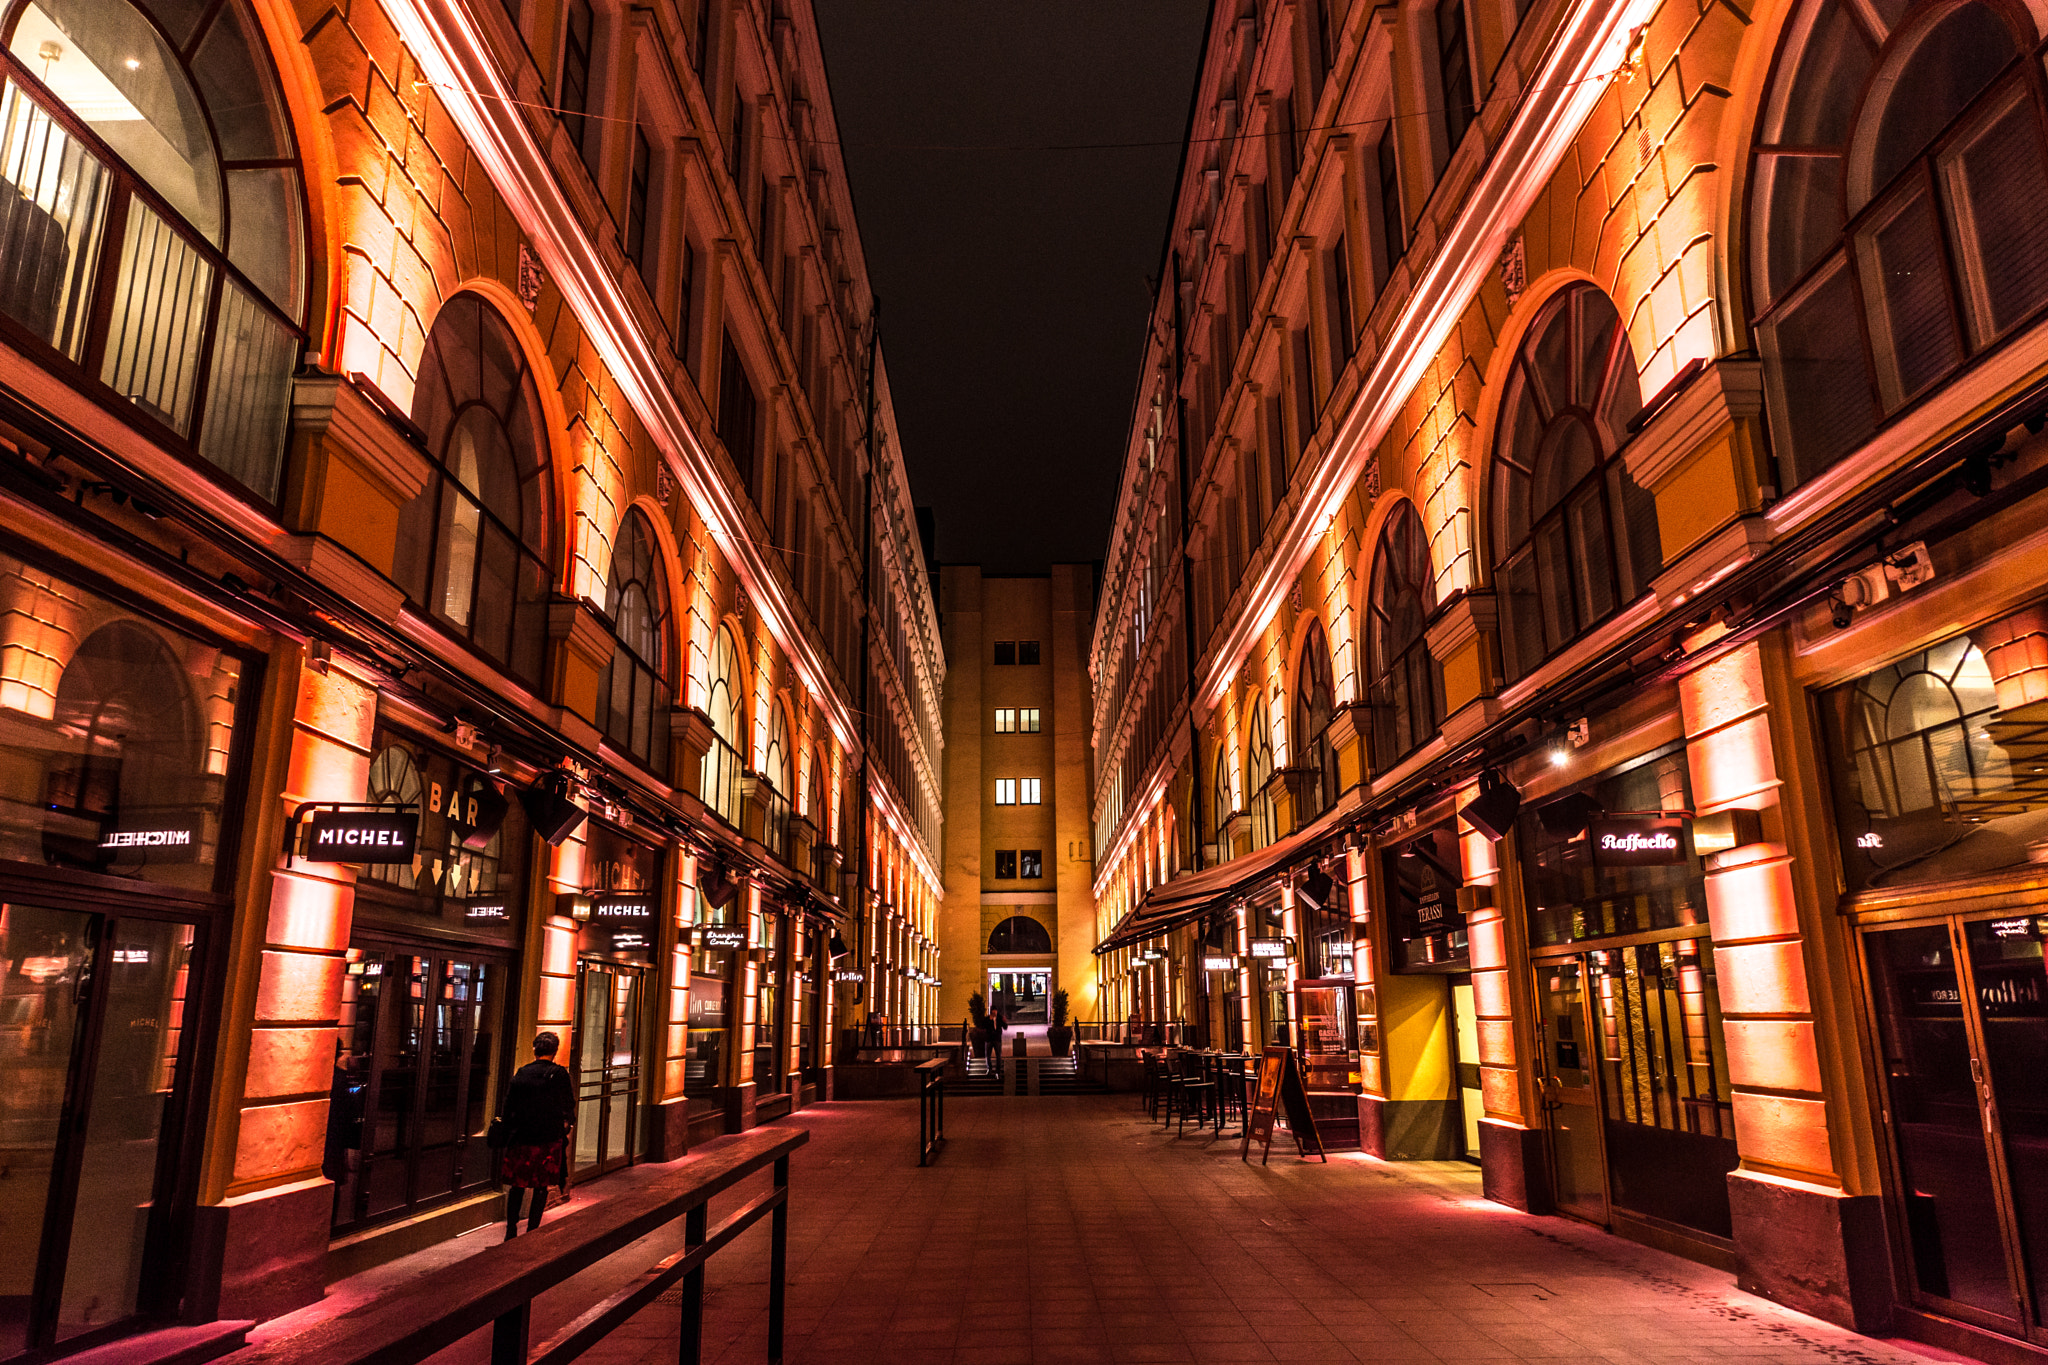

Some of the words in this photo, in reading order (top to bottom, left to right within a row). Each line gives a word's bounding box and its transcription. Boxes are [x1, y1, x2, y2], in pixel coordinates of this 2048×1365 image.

[429, 781, 479, 828] BAR
[319, 828, 404, 846] MICHEL
[1601, 832, 1677, 852] Raffaello
[597, 905, 650, 916] MICHEL
[1417, 903, 1443, 923] TERASSI
[706, 930, 745, 941] Shanghai
[709, 938, 741, 948] Cowboy
